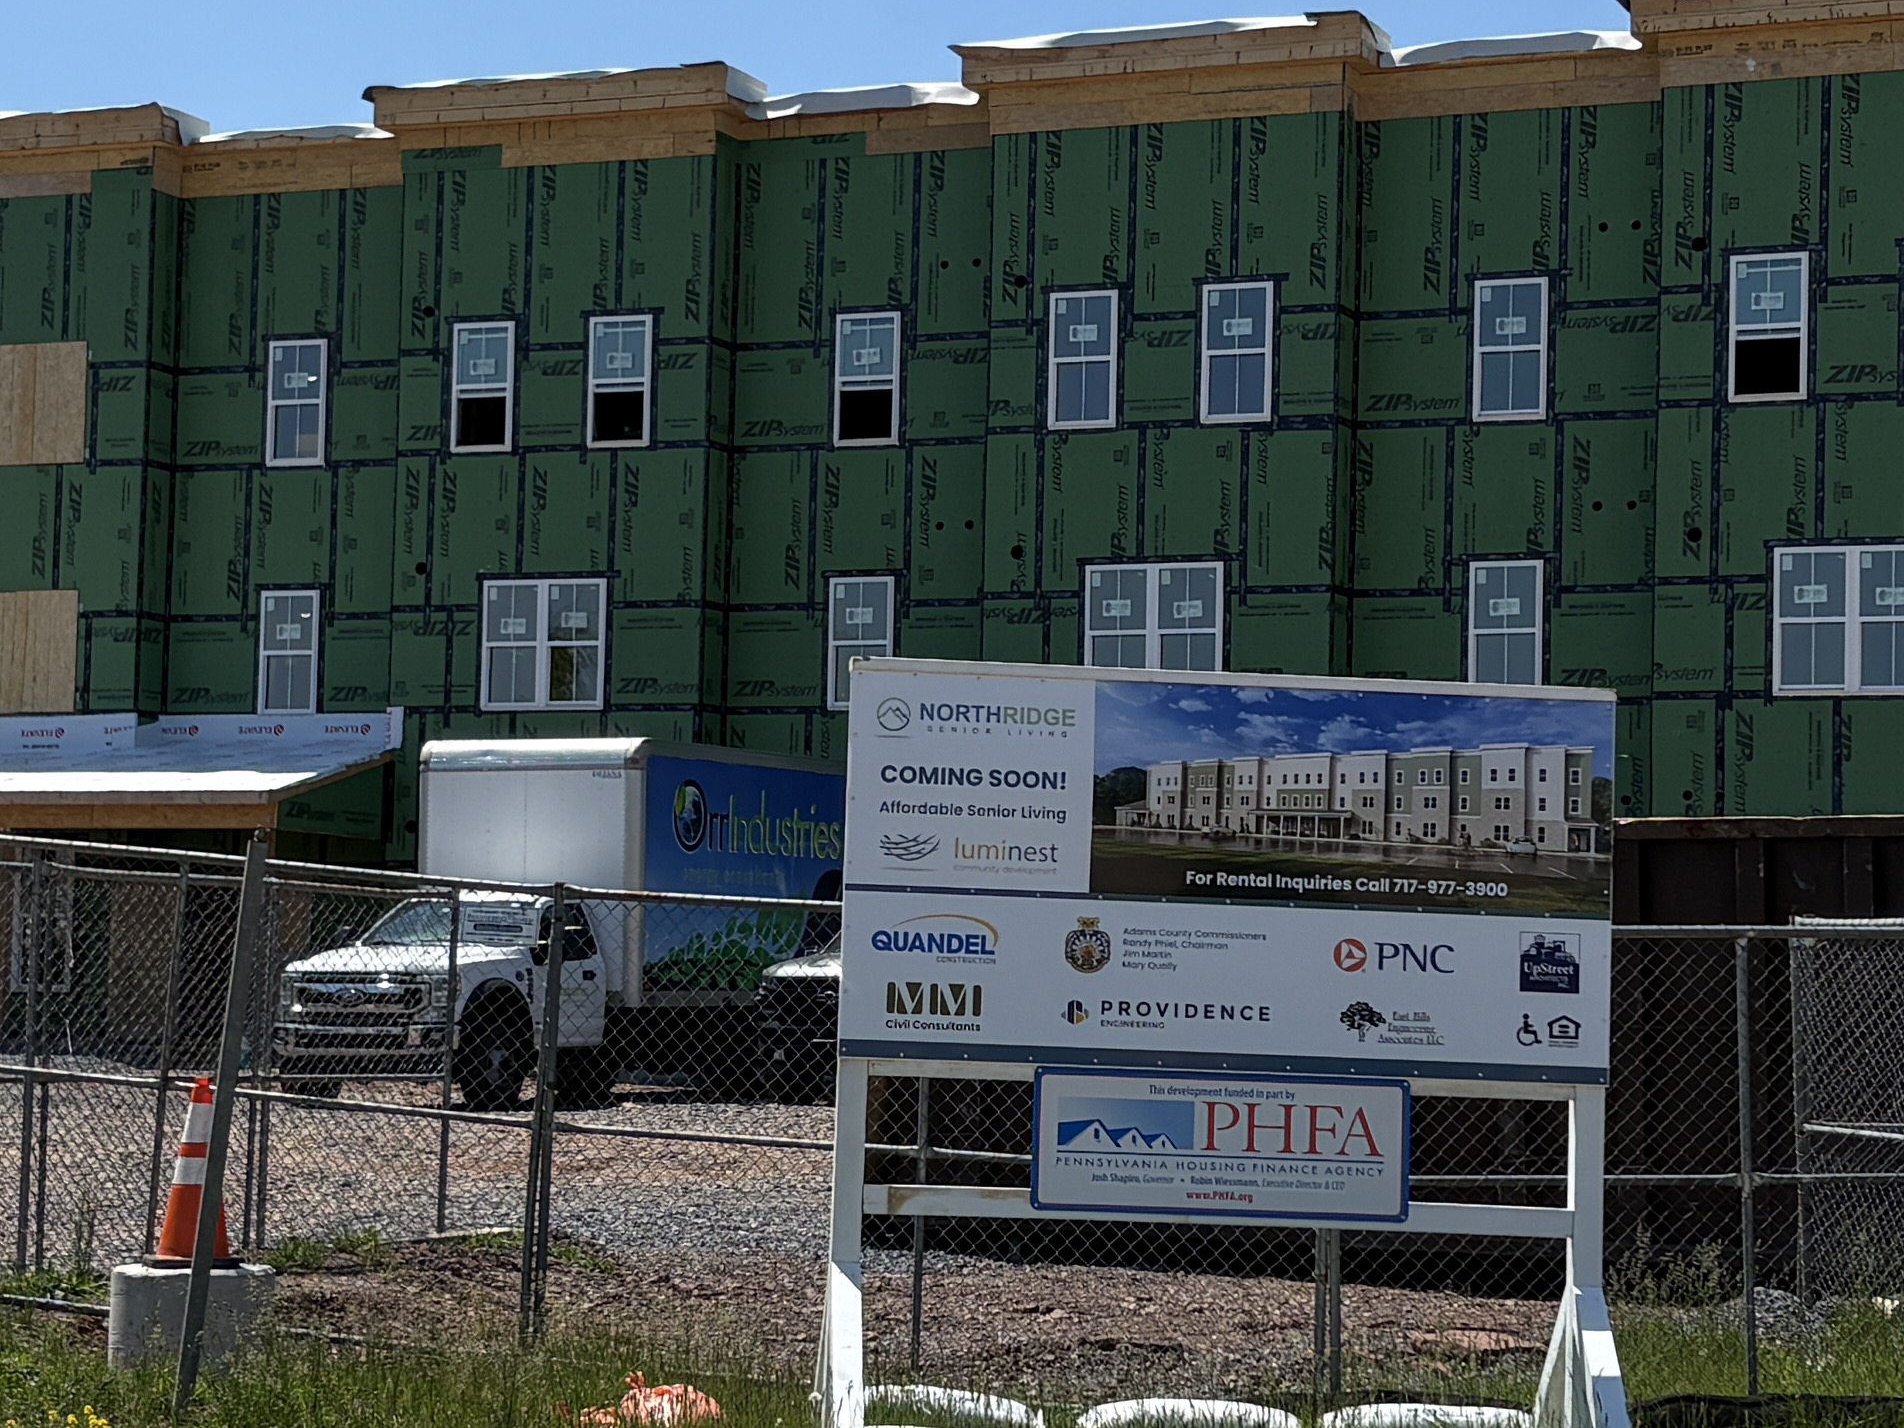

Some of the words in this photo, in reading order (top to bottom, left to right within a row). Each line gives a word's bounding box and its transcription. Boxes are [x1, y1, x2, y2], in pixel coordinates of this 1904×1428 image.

[919, 702, 1076, 727] NORTHRIDGE
[927, 725, 991, 735] SENIOR
[1007, 730, 1068, 738] LIVING
[880, 764, 983, 787] COMING
[989, 769, 1067, 790] SOON!
[879, 801, 964, 816] Affordable
[967, 804, 1017, 818] Senior
[1021, 805, 1067, 824] Living
[954, 837, 1059, 863] luminest
[953, 865, 1000, 875] community
[1002, 867, 1057, 876] development
[1186, 871, 1213, 885] For
[1217, 872, 1272, 888] Rental
[1276, 874, 1352, 893] Inquiries
[1356, 877, 1390, 893] Call
[1393, 879, 1508, 897] 717-977-3900
[1123, 928, 1156, 936] Adams
[1158, 929, 1192, 940] County
[1194, 930, 1266, 941] Commissioners
[871, 930, 996, 956] QUANDEL
[1181, 940, 1228, 950] Chairman
[936, 956, 996, 965] CONSTRUCTION
[1141, 950, 1172, 959] Martin
[1374, 942, 1455, 973] PNC
[1122, 961, 1145, 971] Mary
[1524, 961, 1574, 976] UpStreet
[1100, 999, 1272, 1022] PROVIDENCE
[885, 1019, 911, 1030] Civil
[912, 1020, 981, 1032] Consultants
[1100, 1019, 1165, 1029] ENGINEERING
[1149, 1084, 1166, 1095] This
[1167, 1085, 1223, 1099] development
[1224, 1087, 1254, 1098] funded
[1256, 1088, 1265, 1098] in
[1266, 1089, 1283, 1100] part
[1285, 1090, 1295, 1101] by
[1201, 1101, 1384, 1157] PHFA
[1055, 1157, 1169, 1170] PENNSYLVANIA
[1177, 1161, 1246, 1173] HOUSING
[1253, 1164, 1318, 1175] FINANCE
[1324, 1167, 1384, 1178] AGENCY
[1091, 1173, 1108, 1182] Josh
[1110, 1173, 1141, 1184] Shapiro,
[1186, 1190, 1254, 1204] www.PHFA.org
